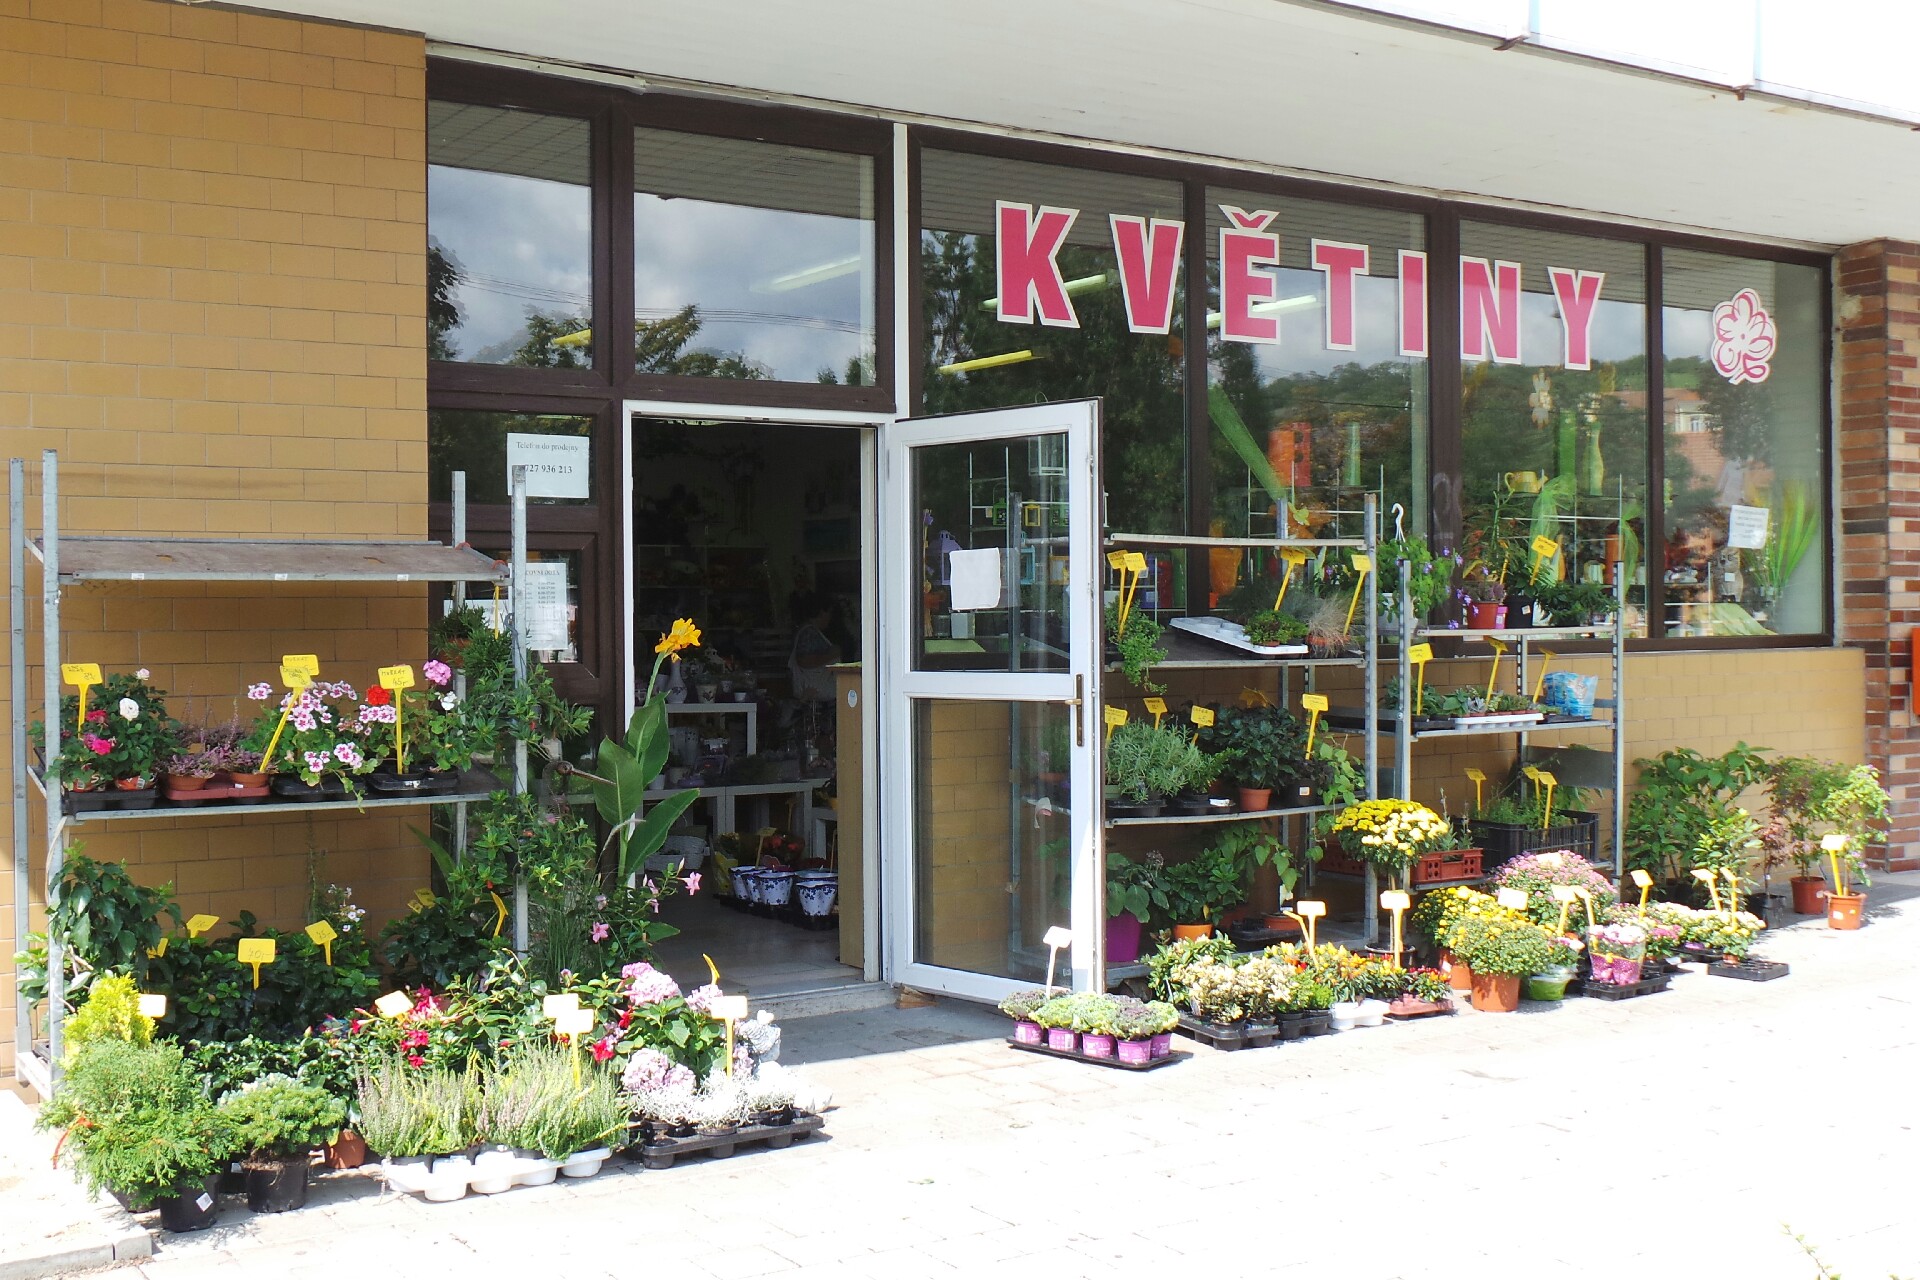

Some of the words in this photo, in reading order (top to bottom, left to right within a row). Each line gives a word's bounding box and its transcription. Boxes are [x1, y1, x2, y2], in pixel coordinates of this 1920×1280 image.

[994, 199, 1606, 372] KVĚTINY
[516, 441, 540, 449] Telefon
[551, 443, 578, 453] prodejny
[541, 464, 556, 473] 936
[558, 465, 573, 474] 213
